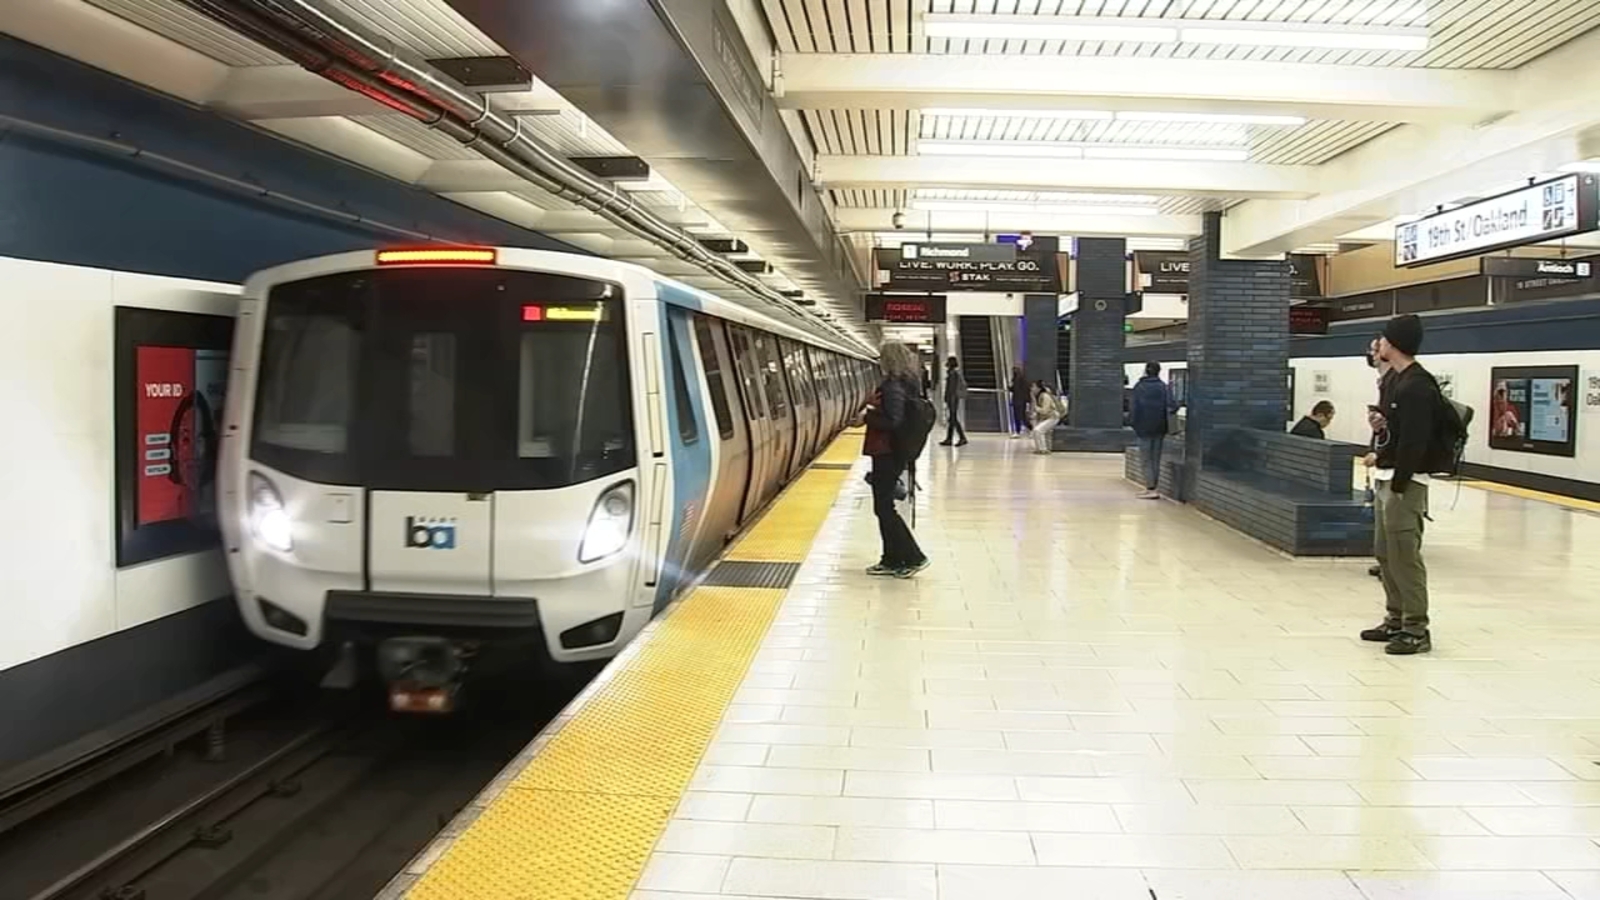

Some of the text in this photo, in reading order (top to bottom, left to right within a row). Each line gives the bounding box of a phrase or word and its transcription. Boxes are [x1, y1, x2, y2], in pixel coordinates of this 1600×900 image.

[1428, 220, 1451, 249] 19th
[920, 247, 968, 257] Richmond
[1017, 261, 1040, 271] GO.
[1537, 262, 1575, 273] Antioch
[961, 273, 991, 281] STAK
[145, 383, 183, 397] YOUR ID
